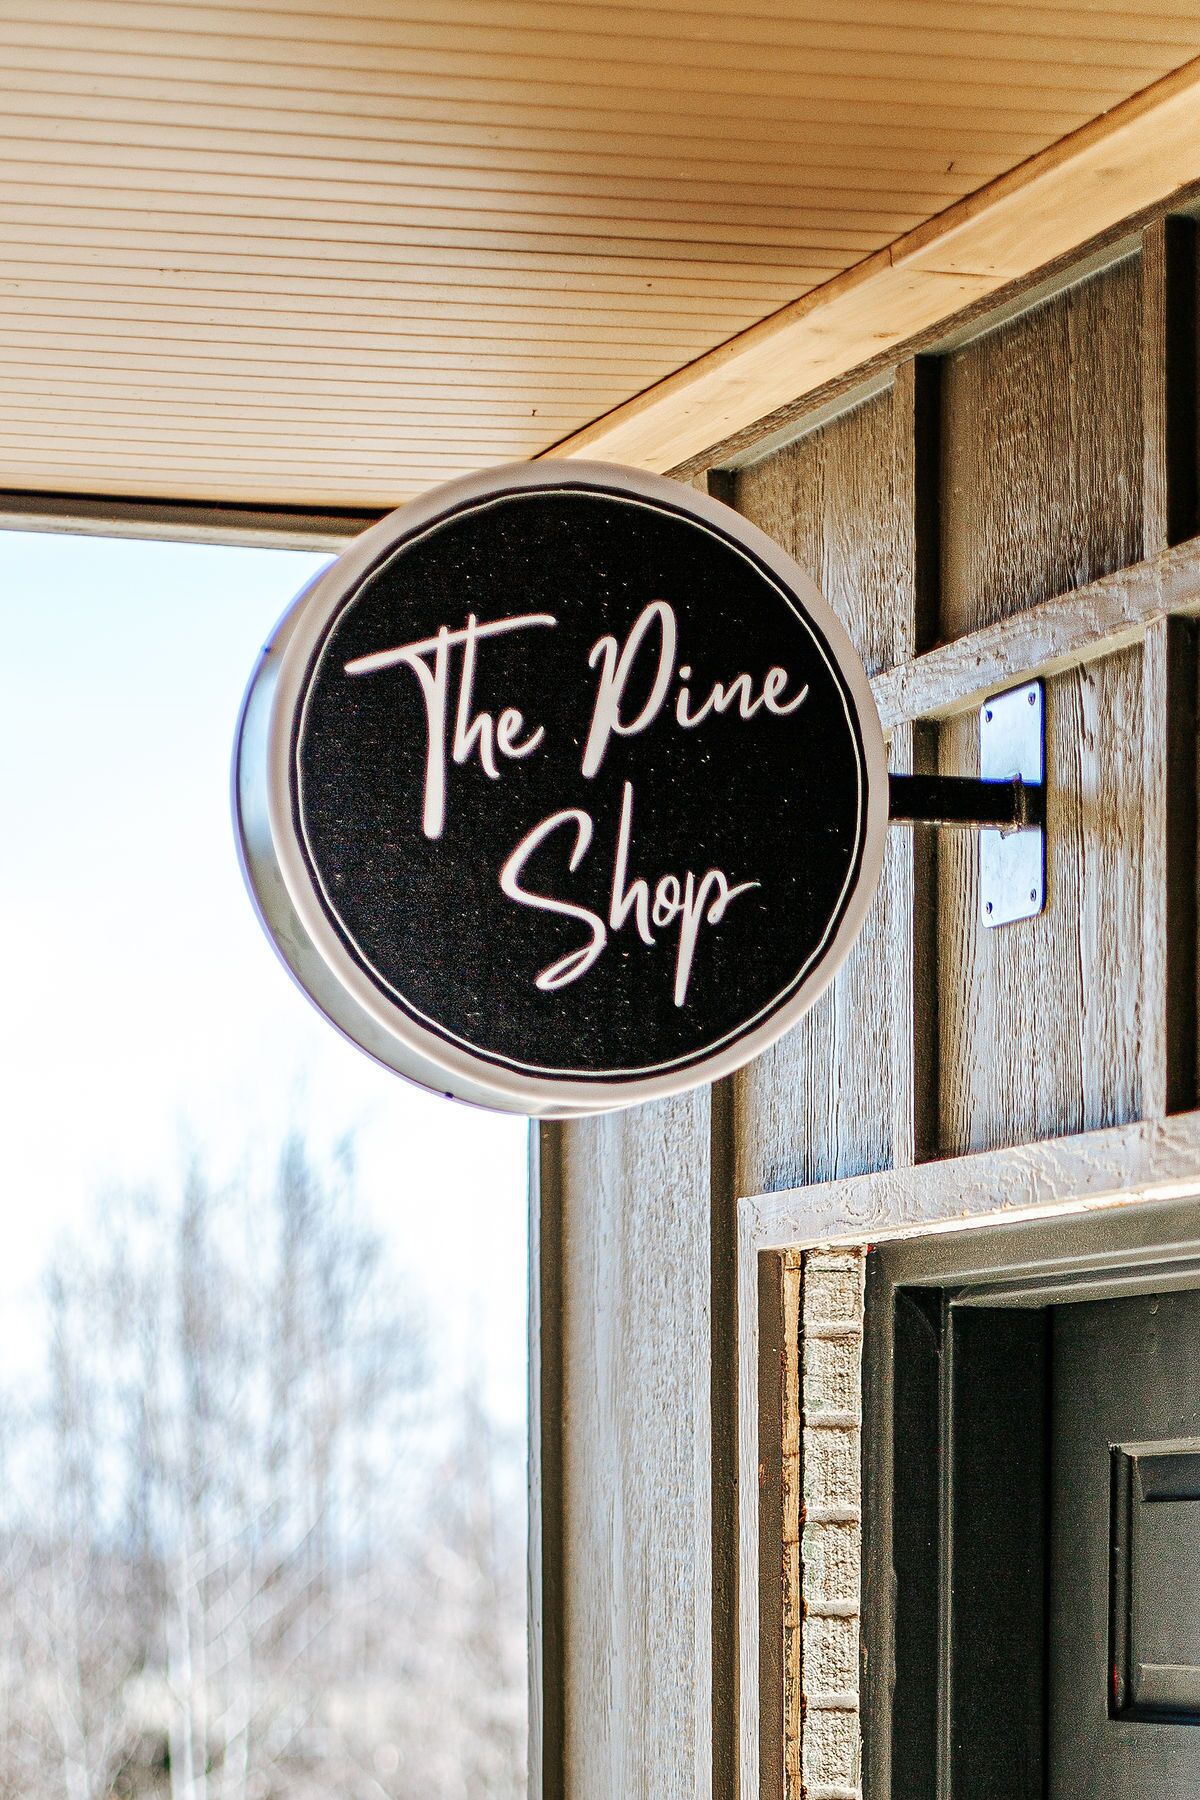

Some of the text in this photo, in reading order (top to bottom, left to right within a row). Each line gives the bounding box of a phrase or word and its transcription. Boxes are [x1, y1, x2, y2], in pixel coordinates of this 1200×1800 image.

[345, 600, 810, 840] The Pine
[501, 780, 761, 1009] Shop
